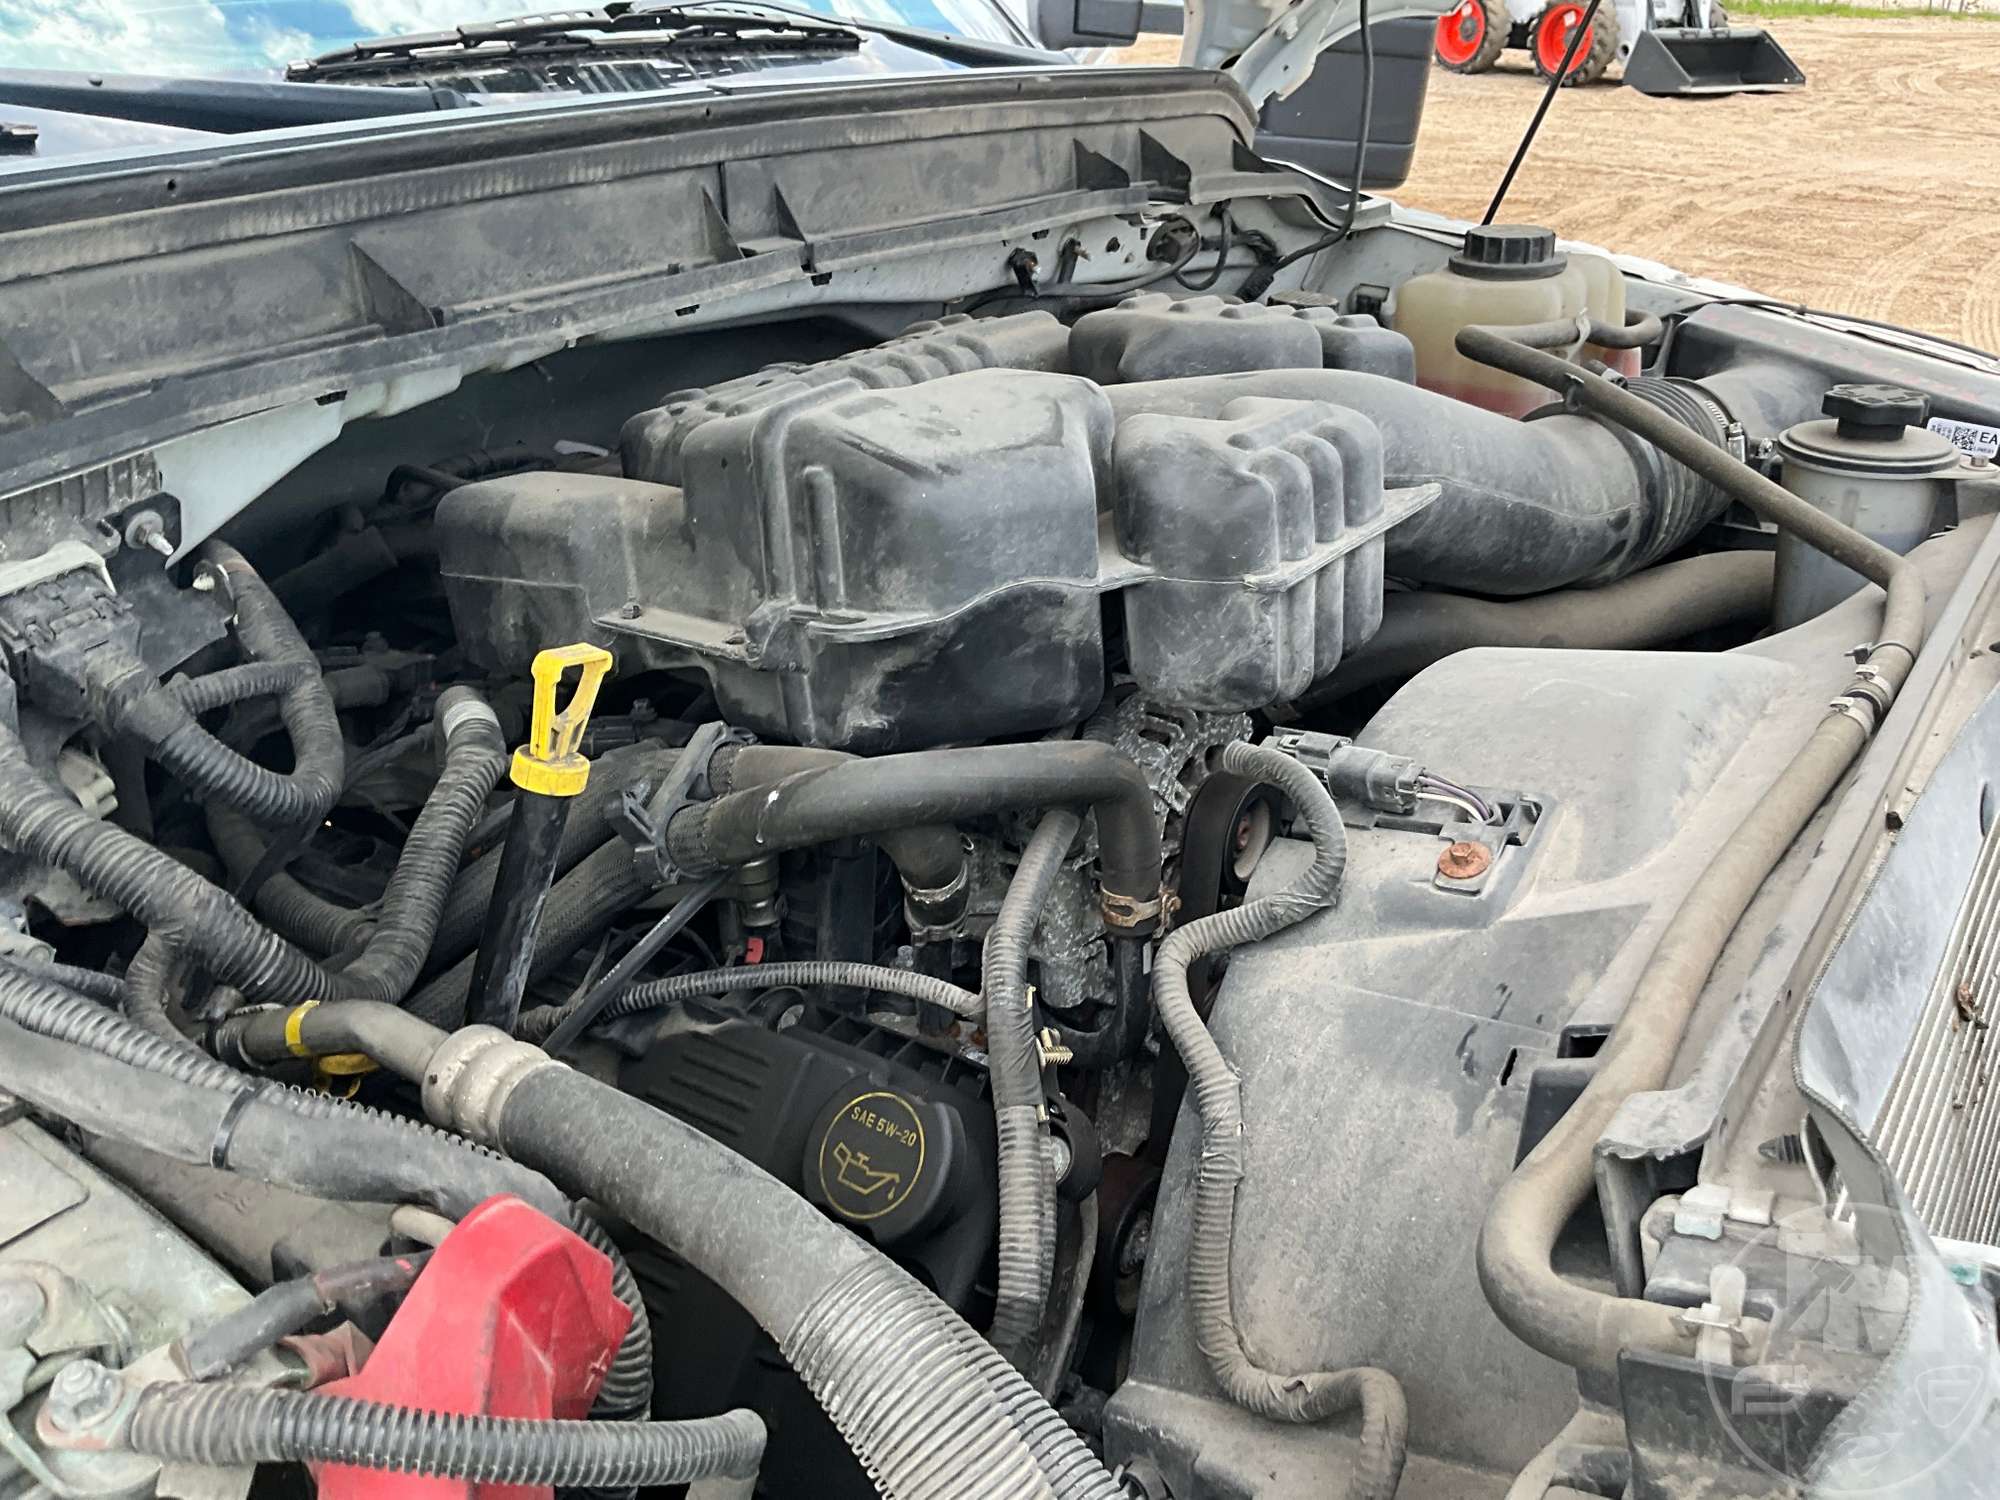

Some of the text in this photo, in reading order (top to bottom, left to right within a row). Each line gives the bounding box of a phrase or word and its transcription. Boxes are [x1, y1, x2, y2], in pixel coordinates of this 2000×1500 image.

[1980, 431, 1998, 445] EA
[851, 1106, 917, 1147] SAE 5W-20
